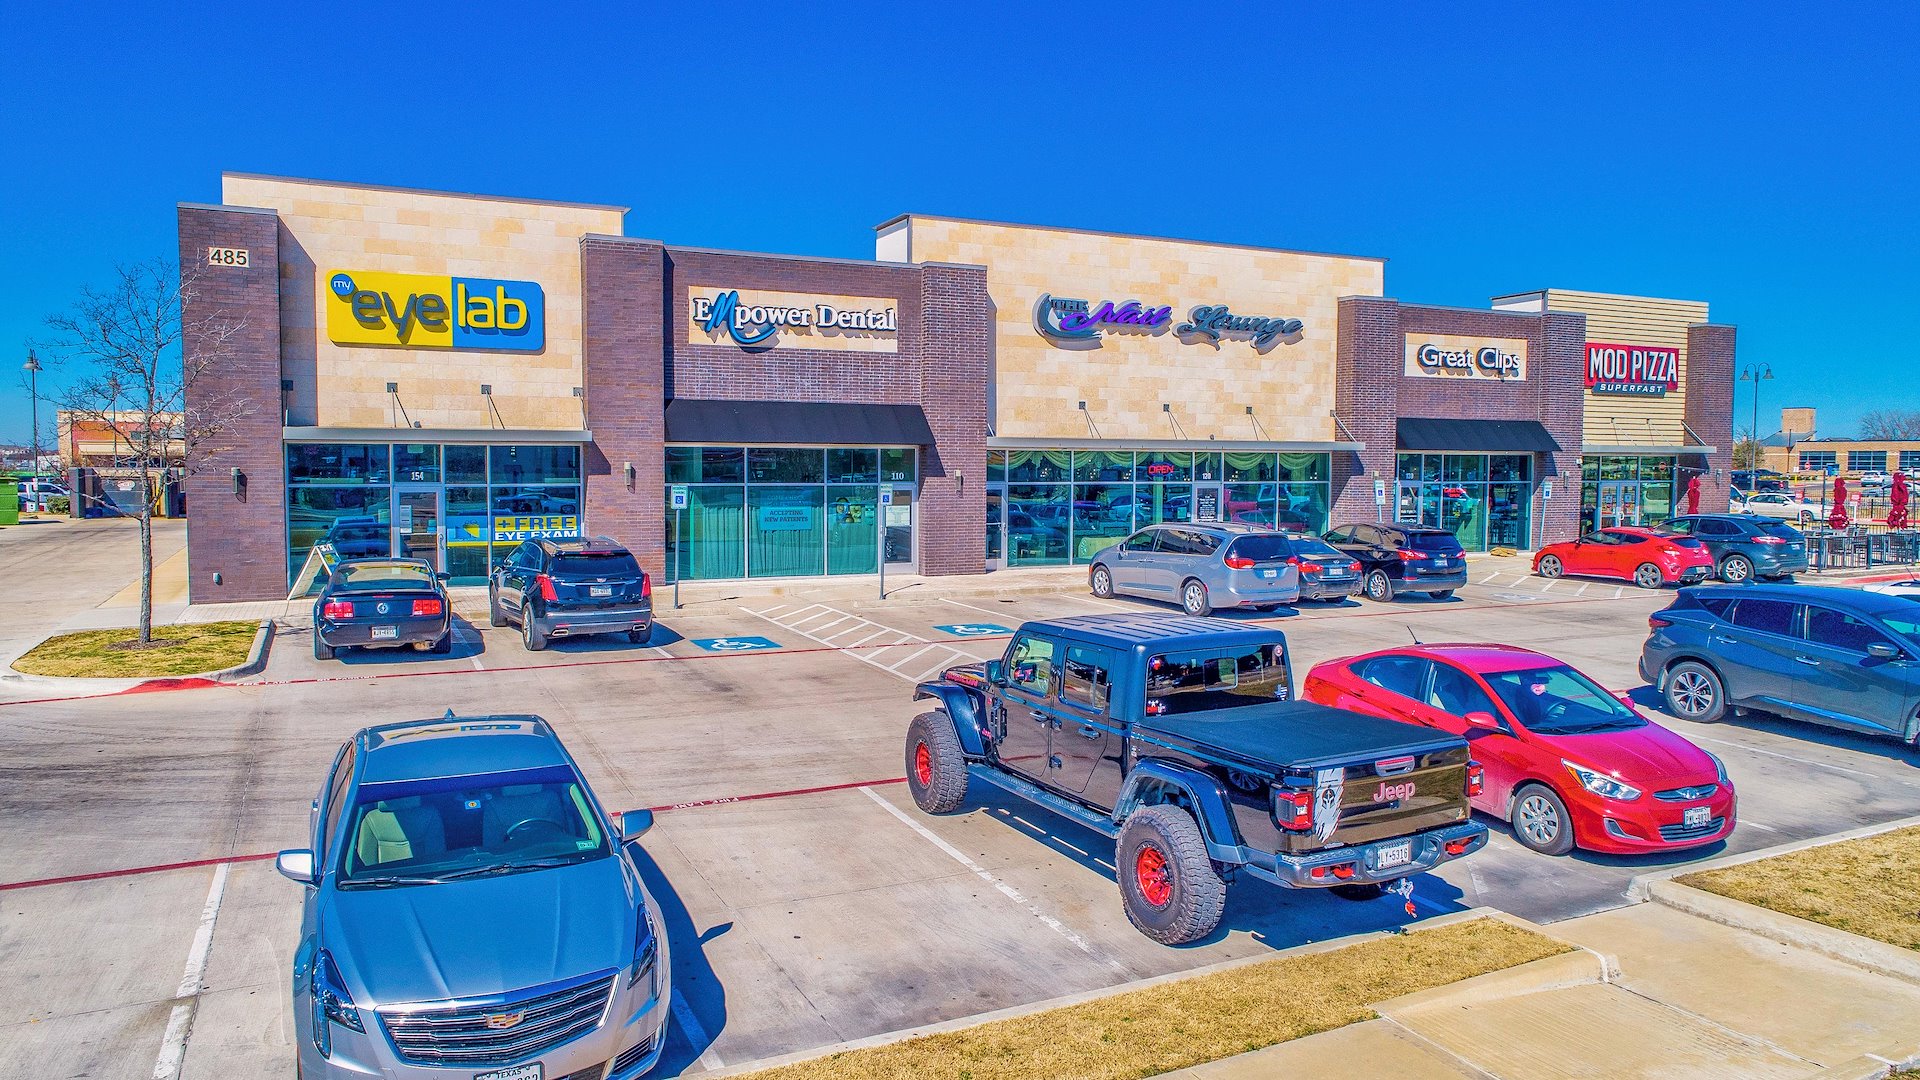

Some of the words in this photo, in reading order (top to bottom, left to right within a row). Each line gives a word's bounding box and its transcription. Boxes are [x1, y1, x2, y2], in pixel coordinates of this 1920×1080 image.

[210, 249, 247, 265] 485
[333, 280, 351, 290] my
[1052, 299, 1089, 312] THE
[817, 304, 897, 331] Dental
[1059, 302, 1173, 331] Nail
[1175, 306, 1303, 348] Lounge
[1419, 345, 1474, 369] Great
[1479, 348, 1521, 371] Clips
[1590, 348, 1627, 380] MOD
[1631, 350, 1677, 382] PIZZA
[1599, 383, 1663, 393] SUPERFAST
[411, 471, 425, 481] 154
[891, 472, 905, 480] 110
[1148, 465, 1175, 474] OPEN
[494, 531, 526, 541] EYE
[1373, 781, 1416, 803] Jeep
[497, 1069, 522, 1079] TEXAS
